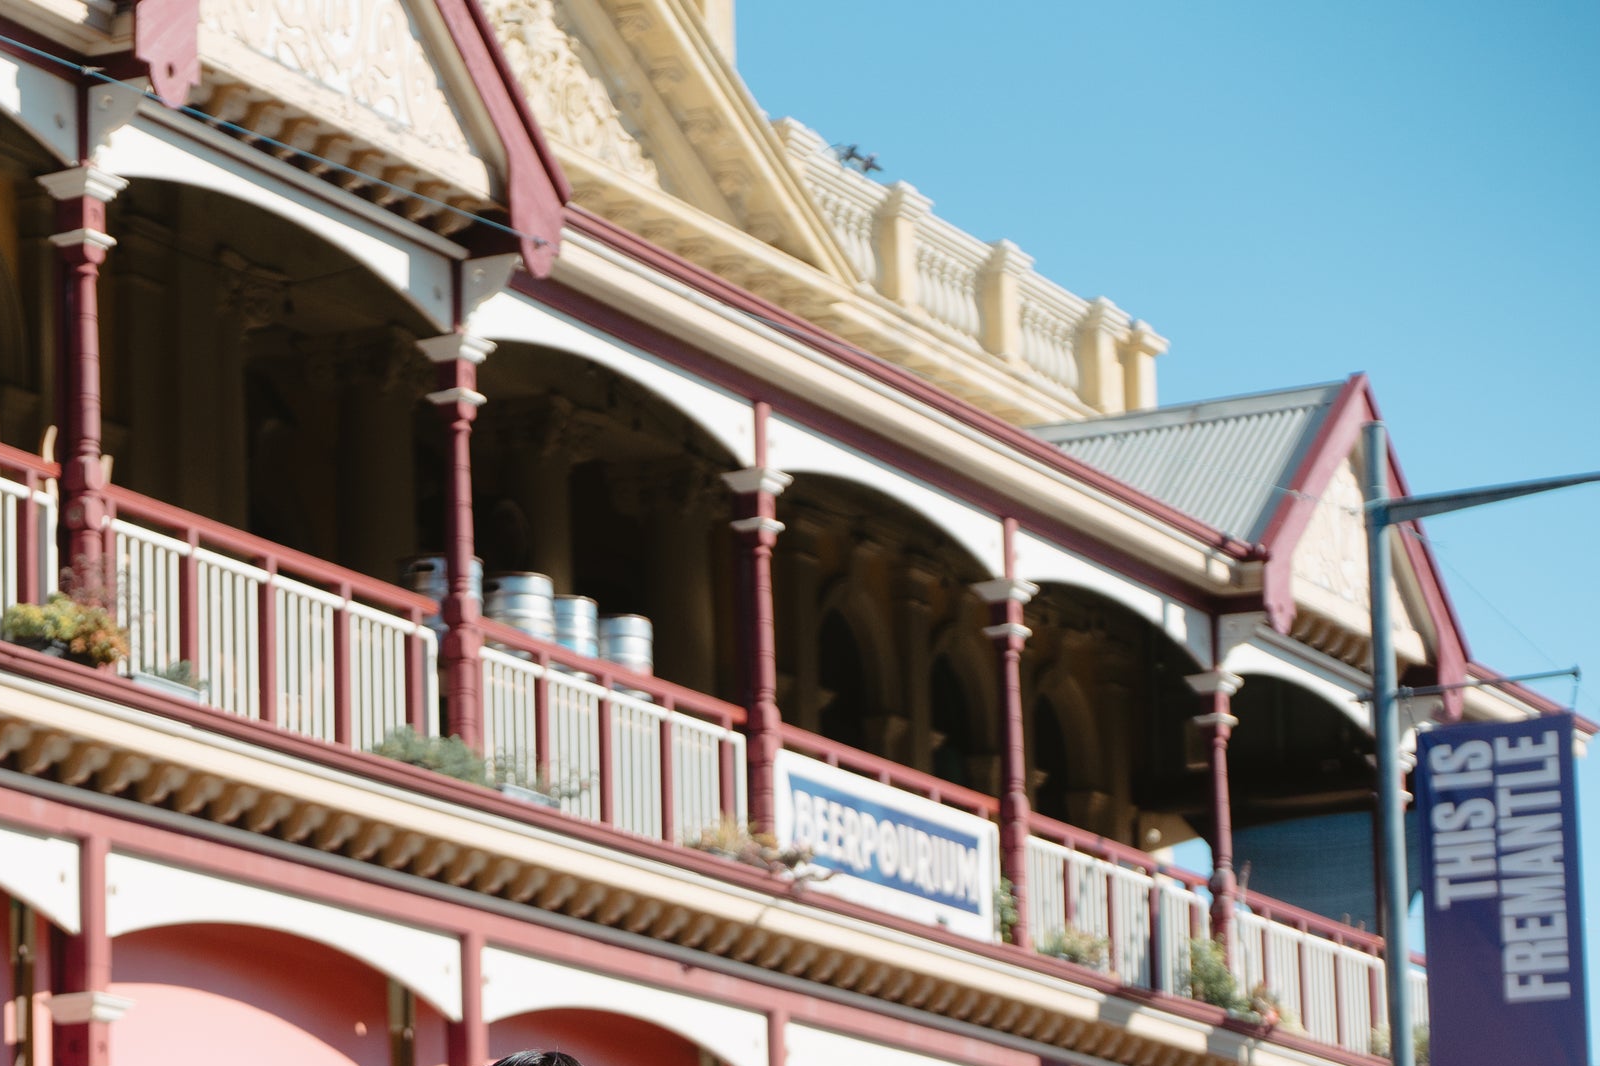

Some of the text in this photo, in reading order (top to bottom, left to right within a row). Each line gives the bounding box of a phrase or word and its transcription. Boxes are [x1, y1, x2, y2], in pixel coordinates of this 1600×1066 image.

[793, 788, 981, 905] BEERPOURIUM
[1427, 738, 1498, 912] THIS IS
[1494, 729, 1572, 1003] FREMANTLE
